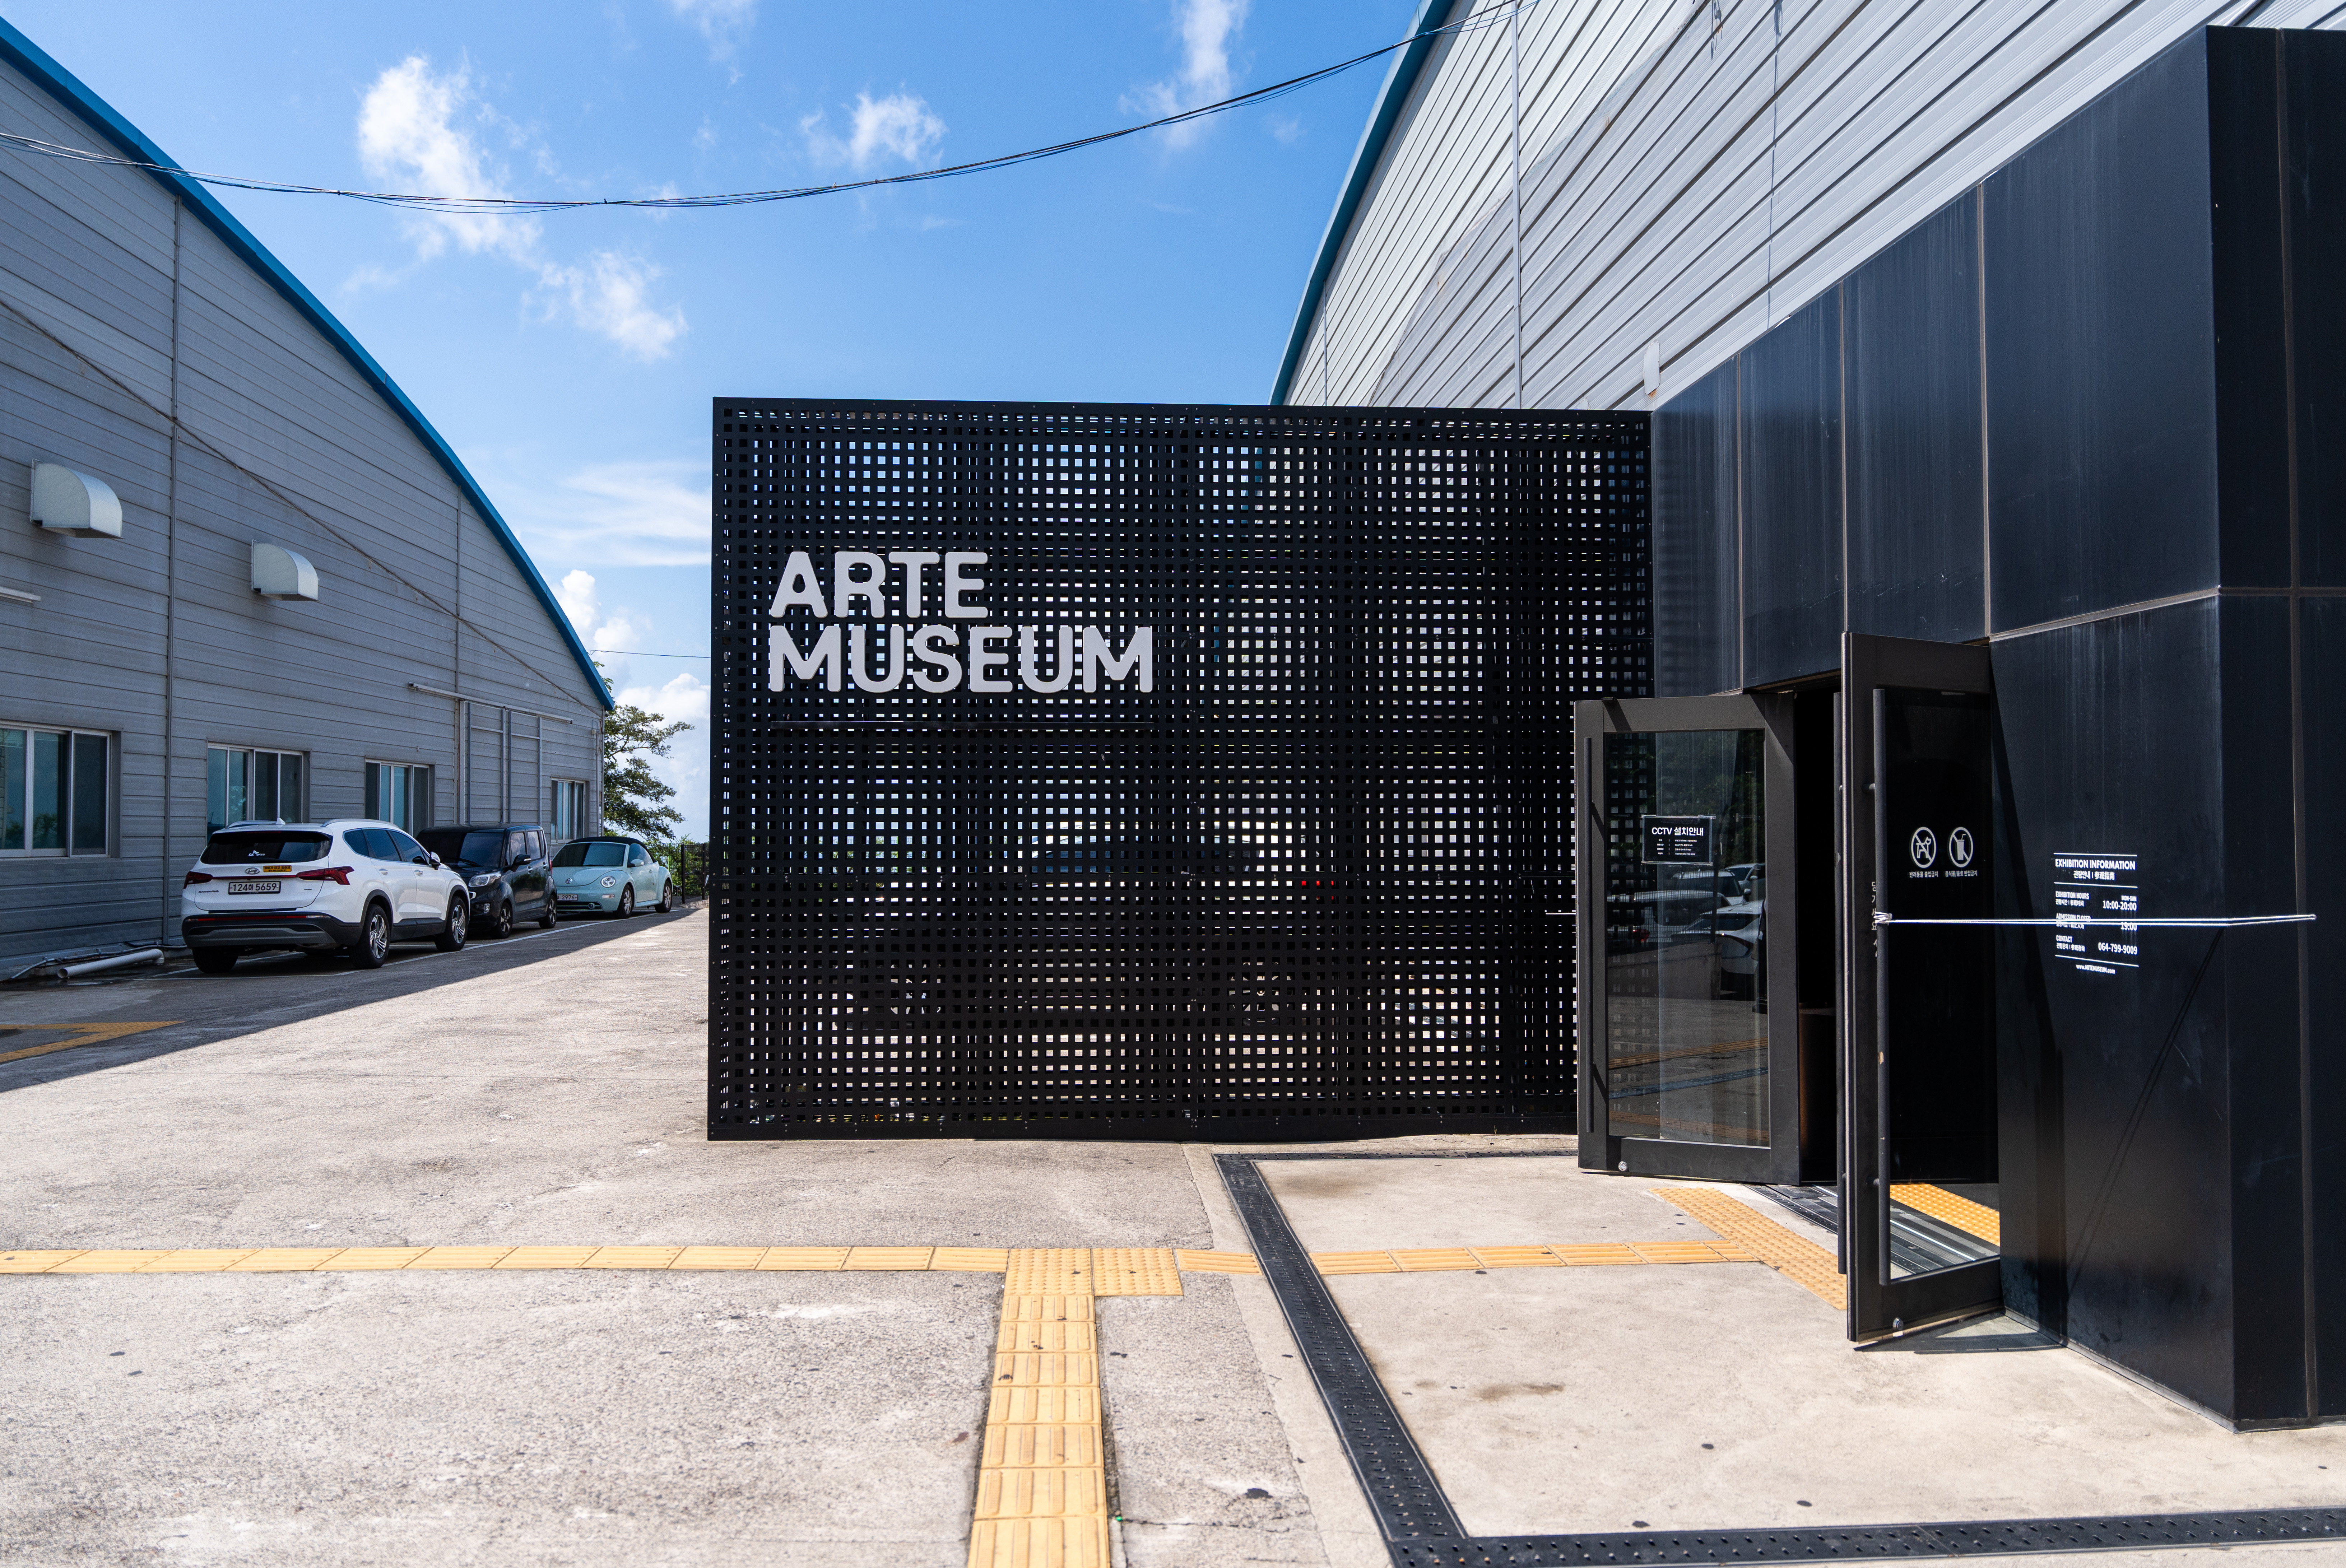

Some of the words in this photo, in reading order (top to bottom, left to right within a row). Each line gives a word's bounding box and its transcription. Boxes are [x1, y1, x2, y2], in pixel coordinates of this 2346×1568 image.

[771, 551, 988, 618] ARTE
[770, 625, 1153, 693] MUSEUM
[1674, 827, 1704, 836] 설치안내
[2055, 859, 2089, 868] EXHIBITION
[2089, 860, 2136, 870] INFORMATION
[2073, 870, 2091, 879] 관람안내
[2103, 900, 2137, 911] 10:00-20:00
[2120, 922, 2137, 931] 19:00
[2056, 935, 2072, 943] CONTACT
[2098, 942, 2138, 955] 064-799-9009
[2076, 964, 2115, 974] www.ARTEMUSEUM.com
